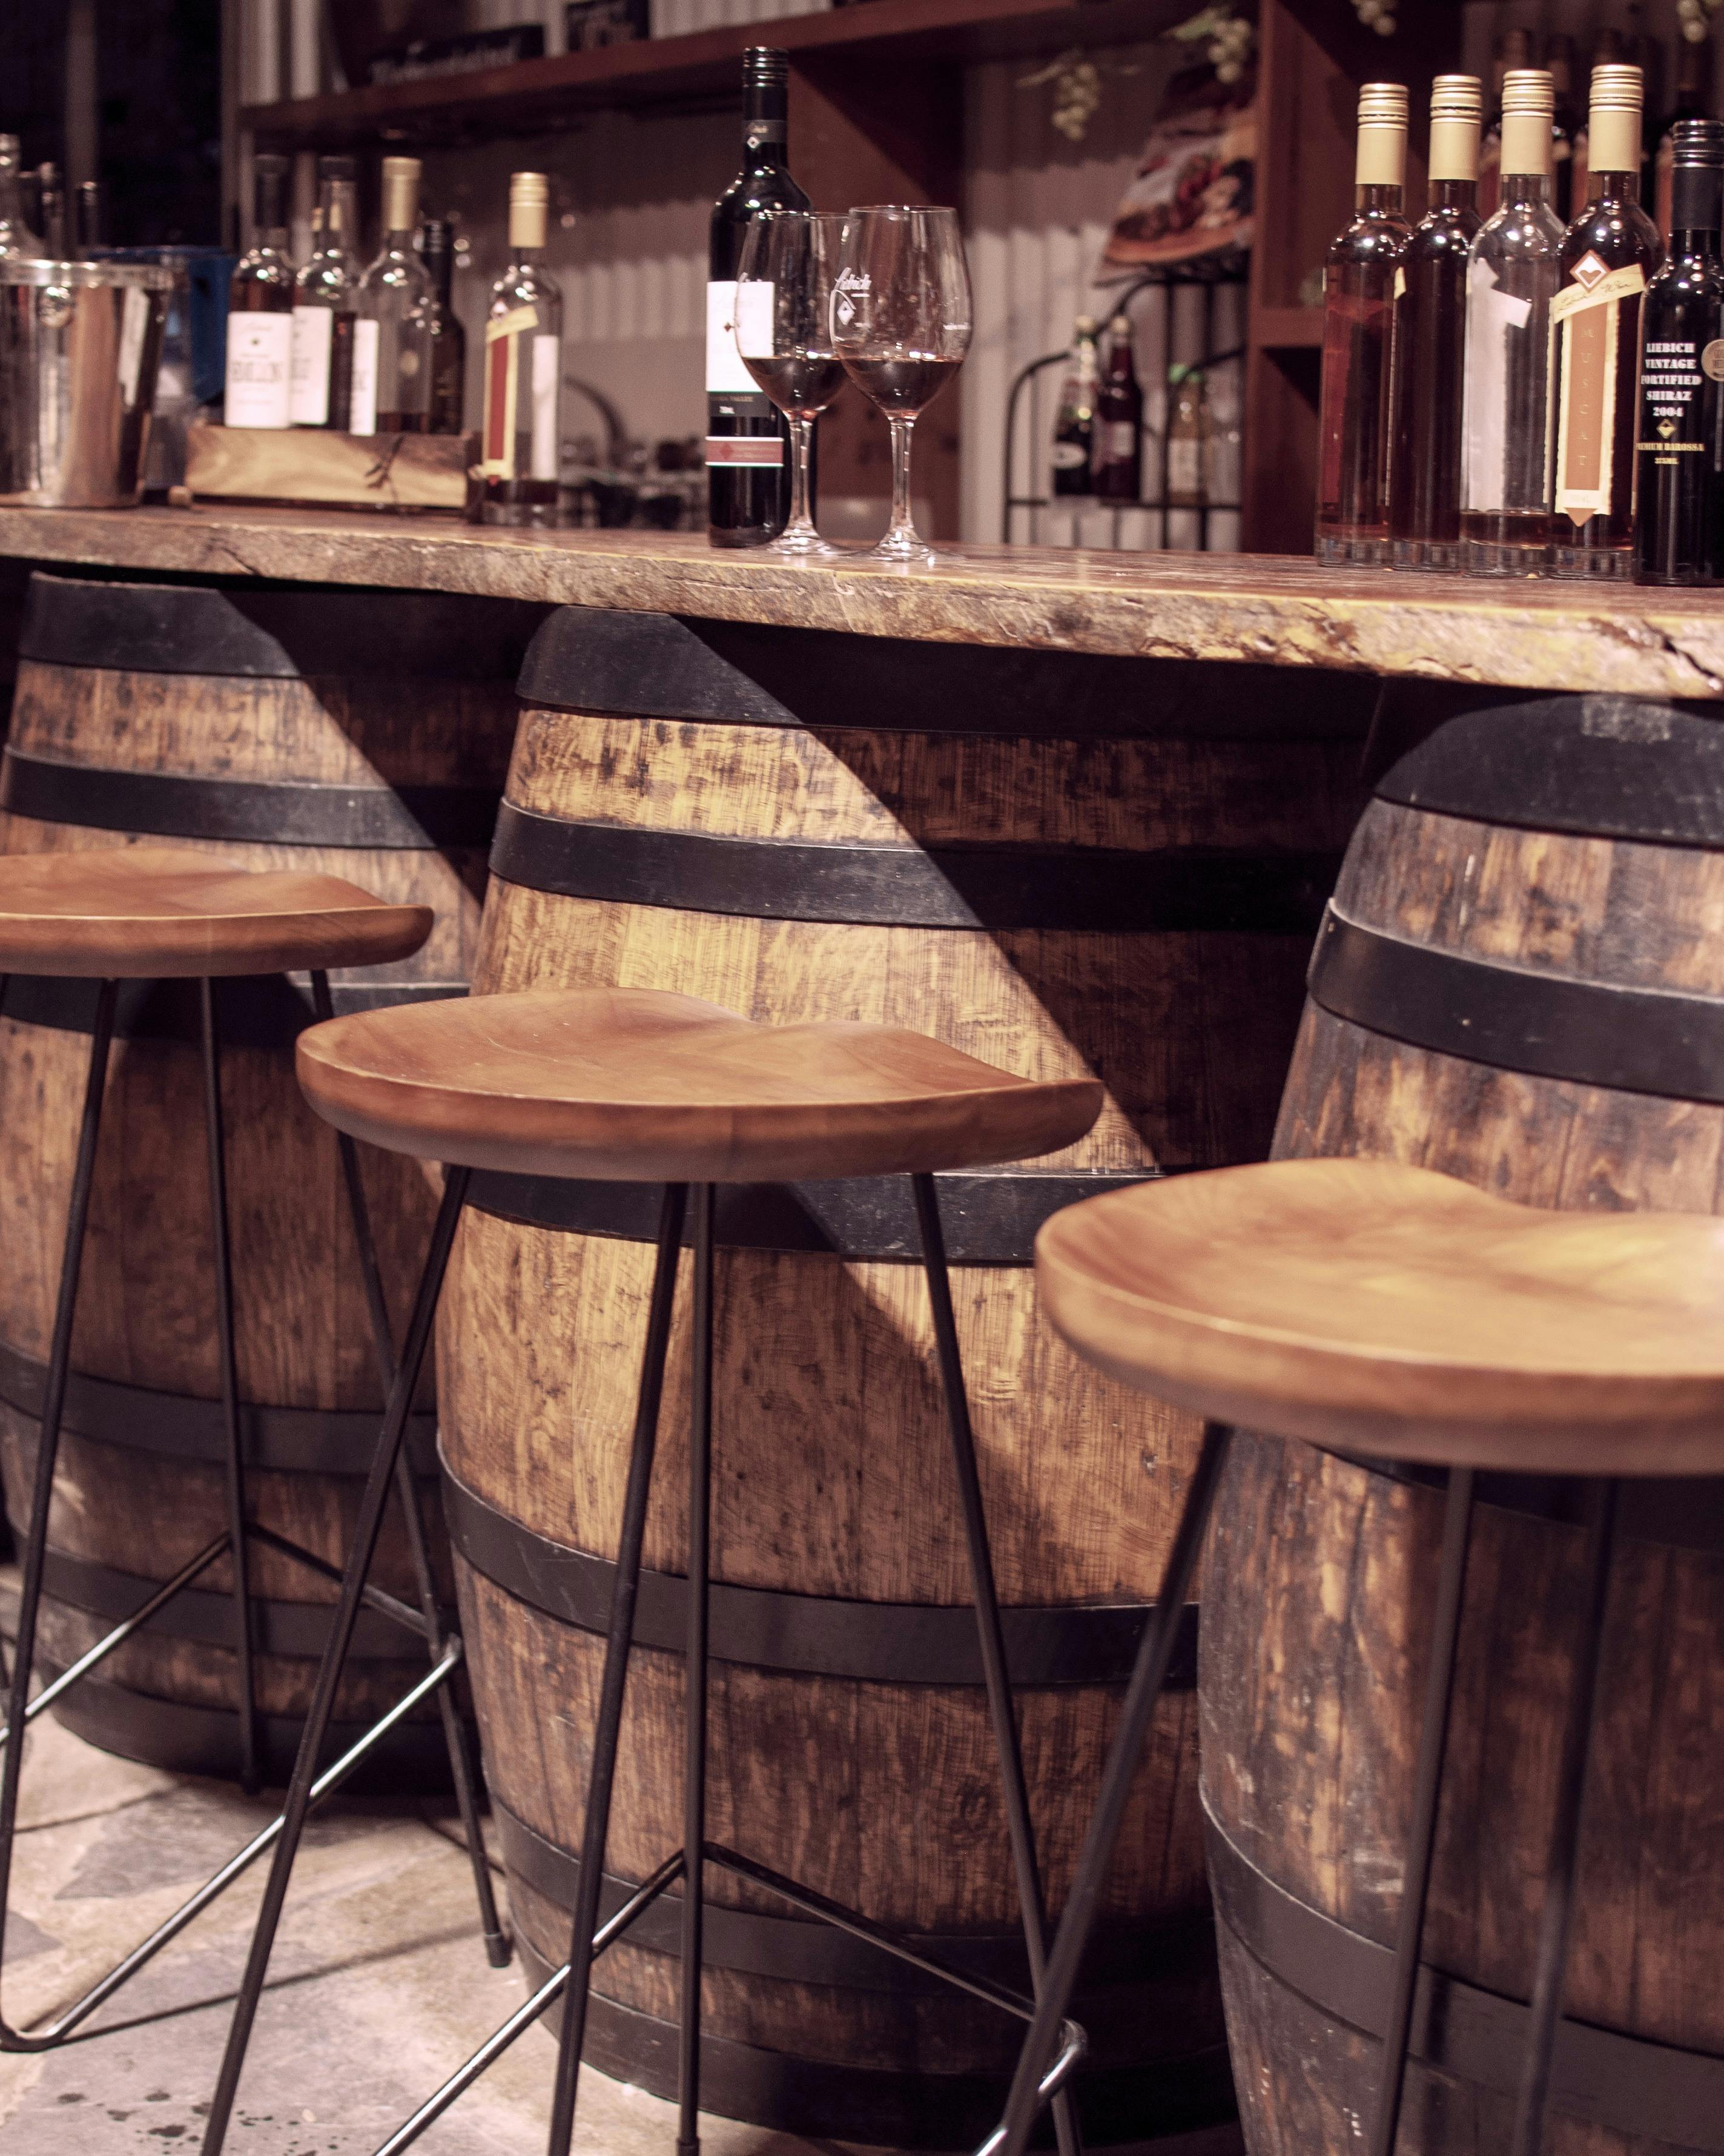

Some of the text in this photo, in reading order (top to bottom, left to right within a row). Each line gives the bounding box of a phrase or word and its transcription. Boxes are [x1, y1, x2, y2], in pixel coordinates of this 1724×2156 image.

[1646, 342, 1696, 353] LIEBICH
[1645, 359, 1696, 369] VINTAGE
[1640, 374, 1702, 385] FORTIFIED
[1577, 328, 1594, 466] MUSCAT
[1646, 391, 1693, 401] SHIRAZ
[1652, 406, 1683, 417] 2004
